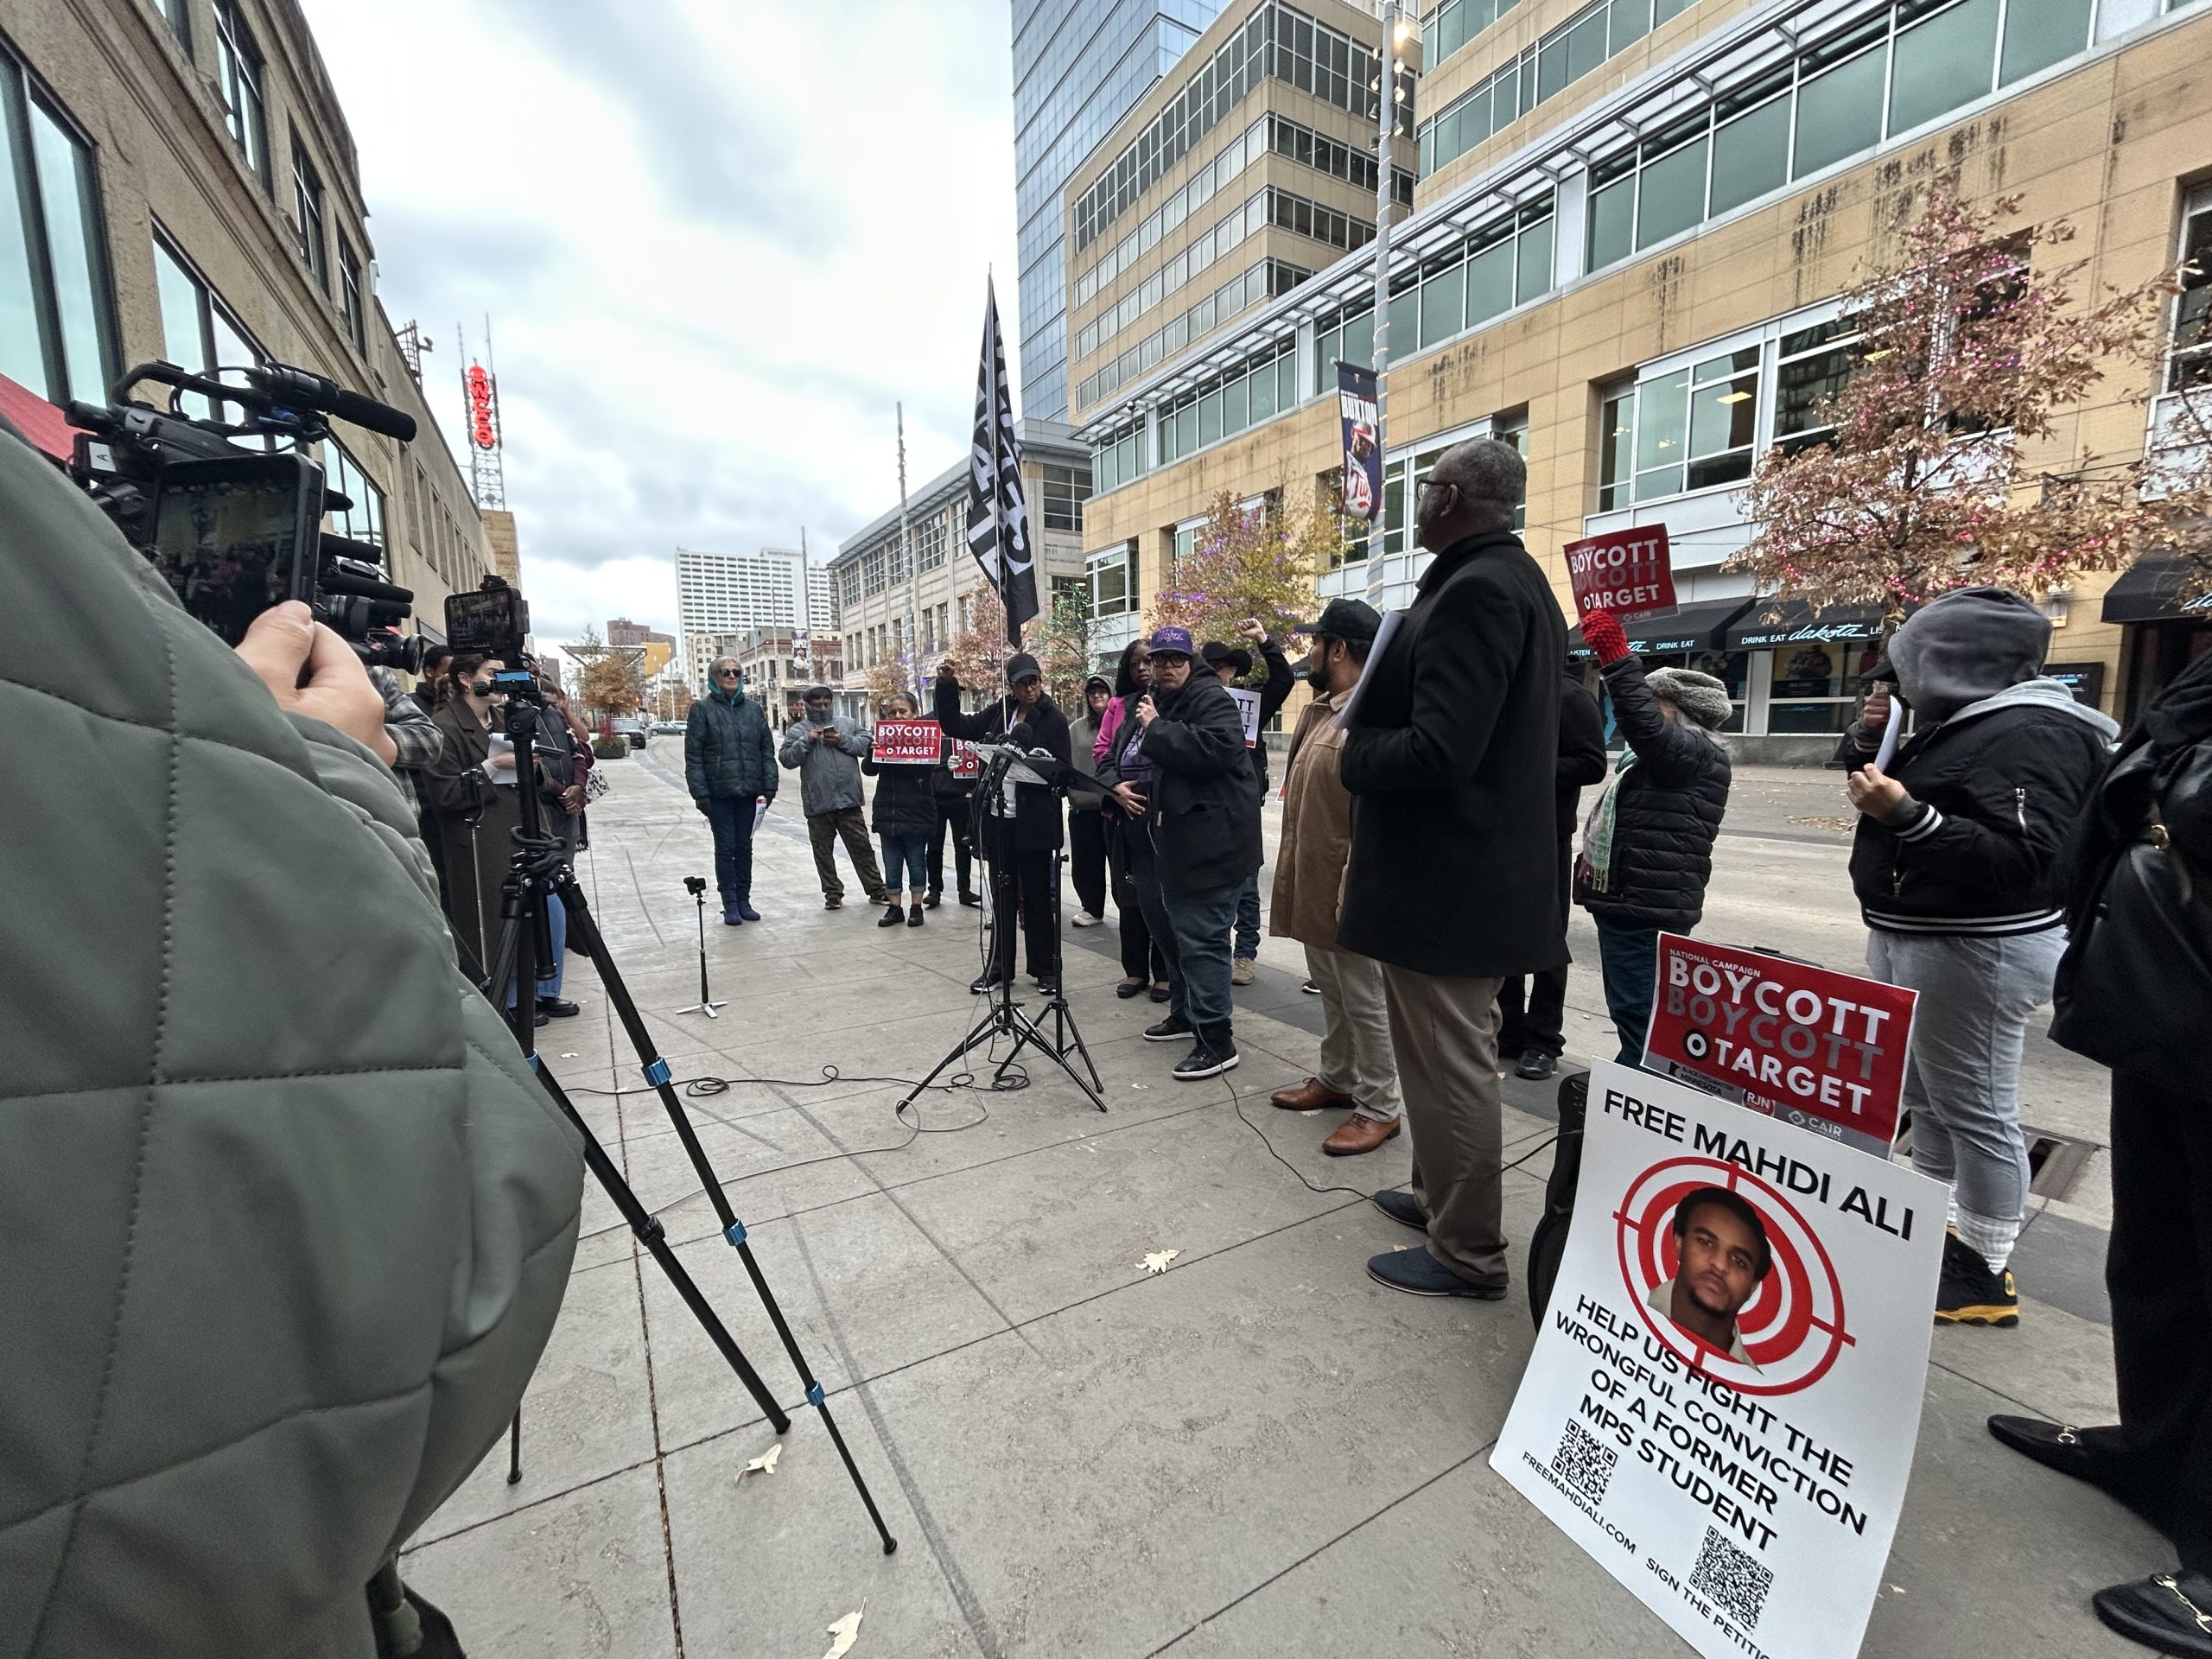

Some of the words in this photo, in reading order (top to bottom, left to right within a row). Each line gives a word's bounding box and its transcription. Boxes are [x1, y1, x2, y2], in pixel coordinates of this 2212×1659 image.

[1341, 395, 1377, 426] BUXTON
[1570, 539, 1659, 575] BOYCOTT
[1573, 560, 1660, 591] BOYCOTT
[1590, 584, 1659, 609] TARGET
[1656, 641, 1678, 651] DRINK
[1681, 639, 1695, 648] EAT
[1741, 636, 1767, 645] DRINK
[1770, 633, 1786, 643] EAT
[1789, 623, 1868, 643] dakota
[879, 727, 938, 737] BOYCOTT
[895, 747, 935, 755] TARGET
[1669, 949, 1710, 965] NATIONAL
[1712, 959, 1761, 978] CAMPAIGN
[1669, 956, 1891, 1045] BOYCOTT
[1666, 985, 1885, 1080] BOYCOTT
[1714, 1040, 1872, 1116] TARGET
[1747, 1091, 1770, 1109] RJN
[1808, 1117, 1842, 1137] CAIR
[1604, 1088, 1686, 1143] FREE
[1693, 1122, 1831, 1204] MAHDI
[1839, 1185, 1914, 1242] ALI
[1576, 1294, 1639, 1342] HELP
[1643, 1335, 1681, 1374] US
[1685, 1363, 1778, 1435] FIGHT
[1784, 1423, 1853, 1488] THE
[1556, 1310, 1678, 1409] WRONGFUL
[1684, 1400, 1867, 1536] CONVICTION
[1591, 1369, 1627, 1401] OF
[1626, 1396, 1647, 1424] A
[1652, 1410, 1778, 1516] FORMER
[1579, 1394, 1635, 1447] MPS
[1637, 1438, 1778, 1552] STUDENT
[1522, 1451, 1637, 1554] FREEMAHDIALI.COM
[1645, 1558, 1681, 1592] SIGN
[1683, 1586, 1711, 1619] THE
